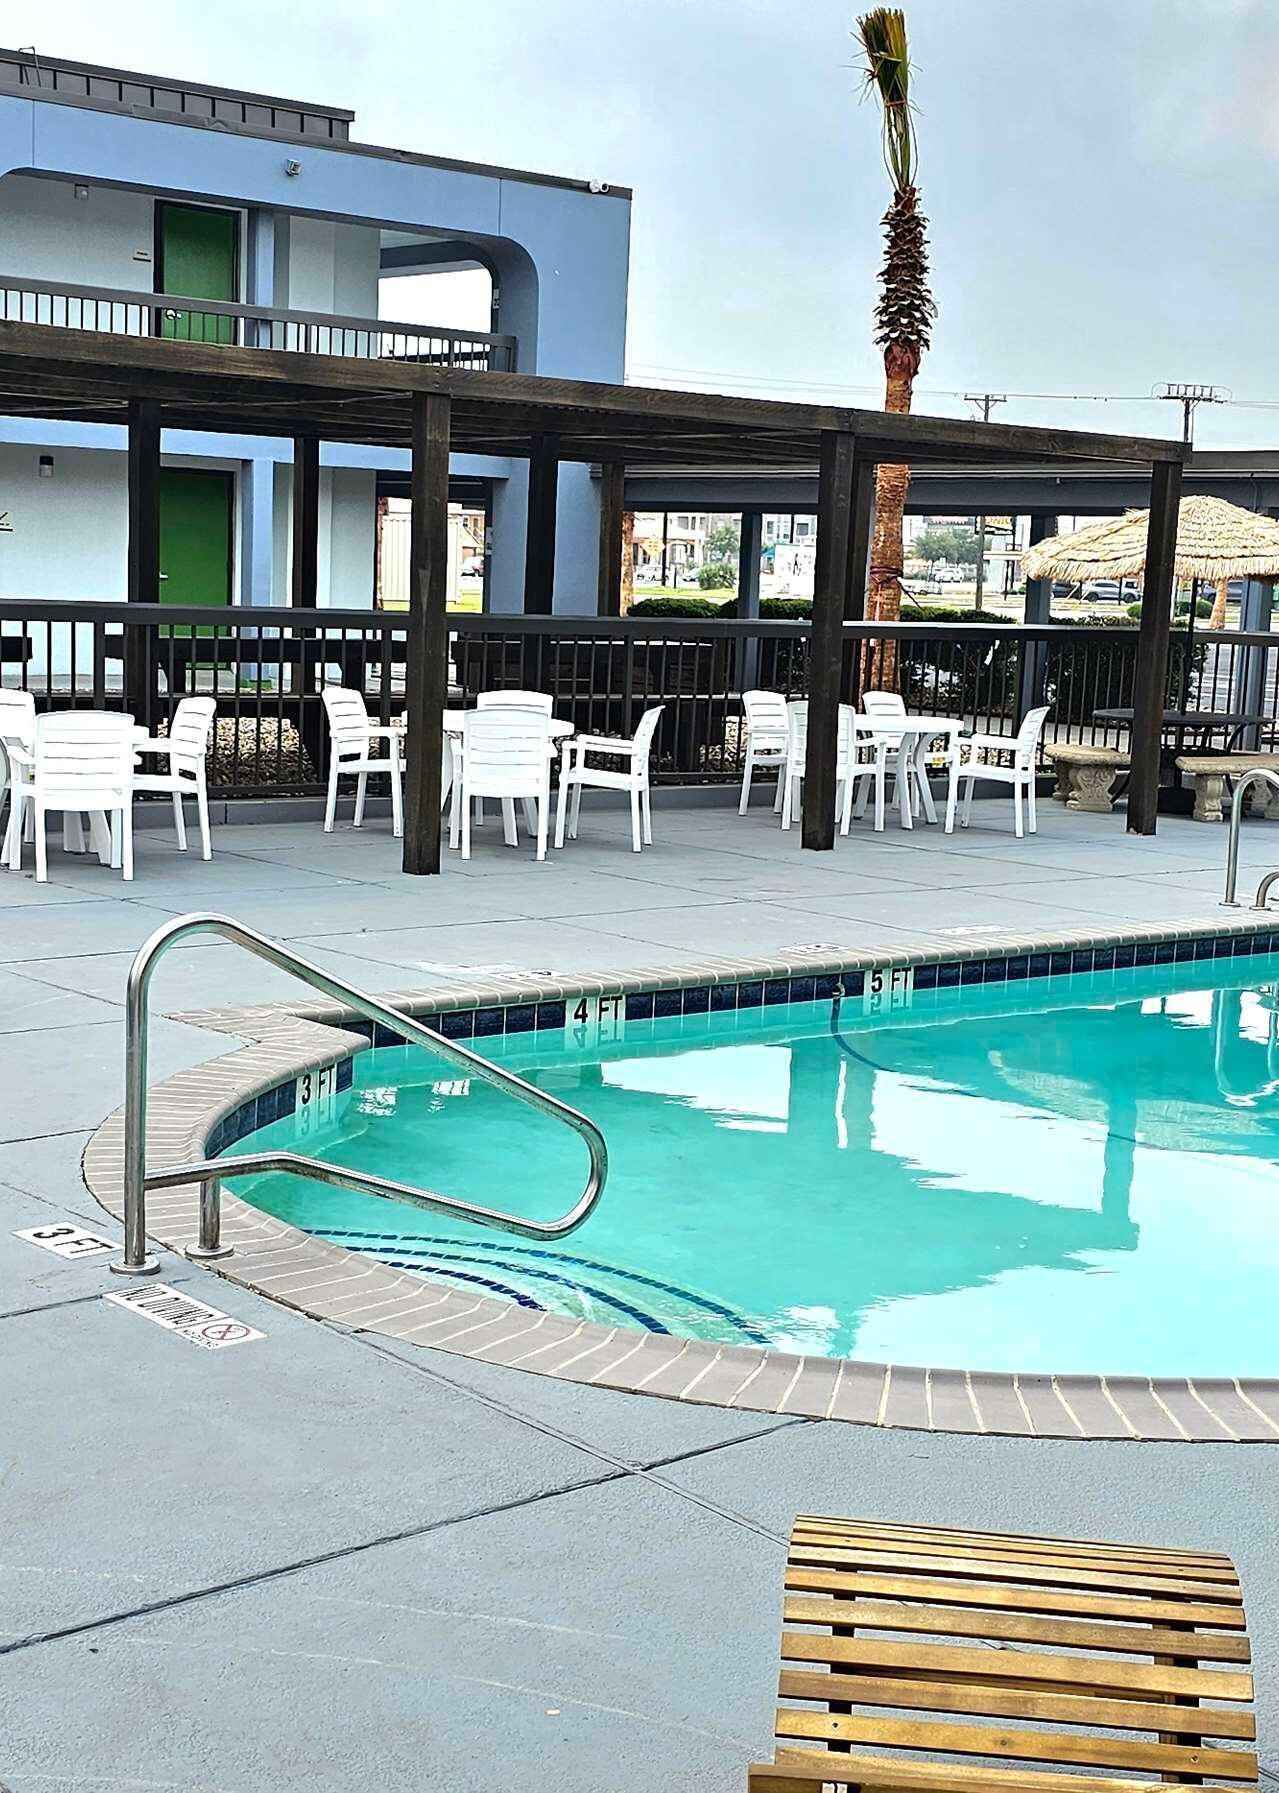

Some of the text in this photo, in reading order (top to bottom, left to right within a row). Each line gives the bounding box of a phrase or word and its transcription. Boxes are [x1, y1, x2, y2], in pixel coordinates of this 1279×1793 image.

[871, 966, 911, 993] 5 FT
[574, 995, 623, 1023] 4 FT
[302, 1064, 335, 1105] 3 FT
[33, 1228, 115, 1254] 3 FT
